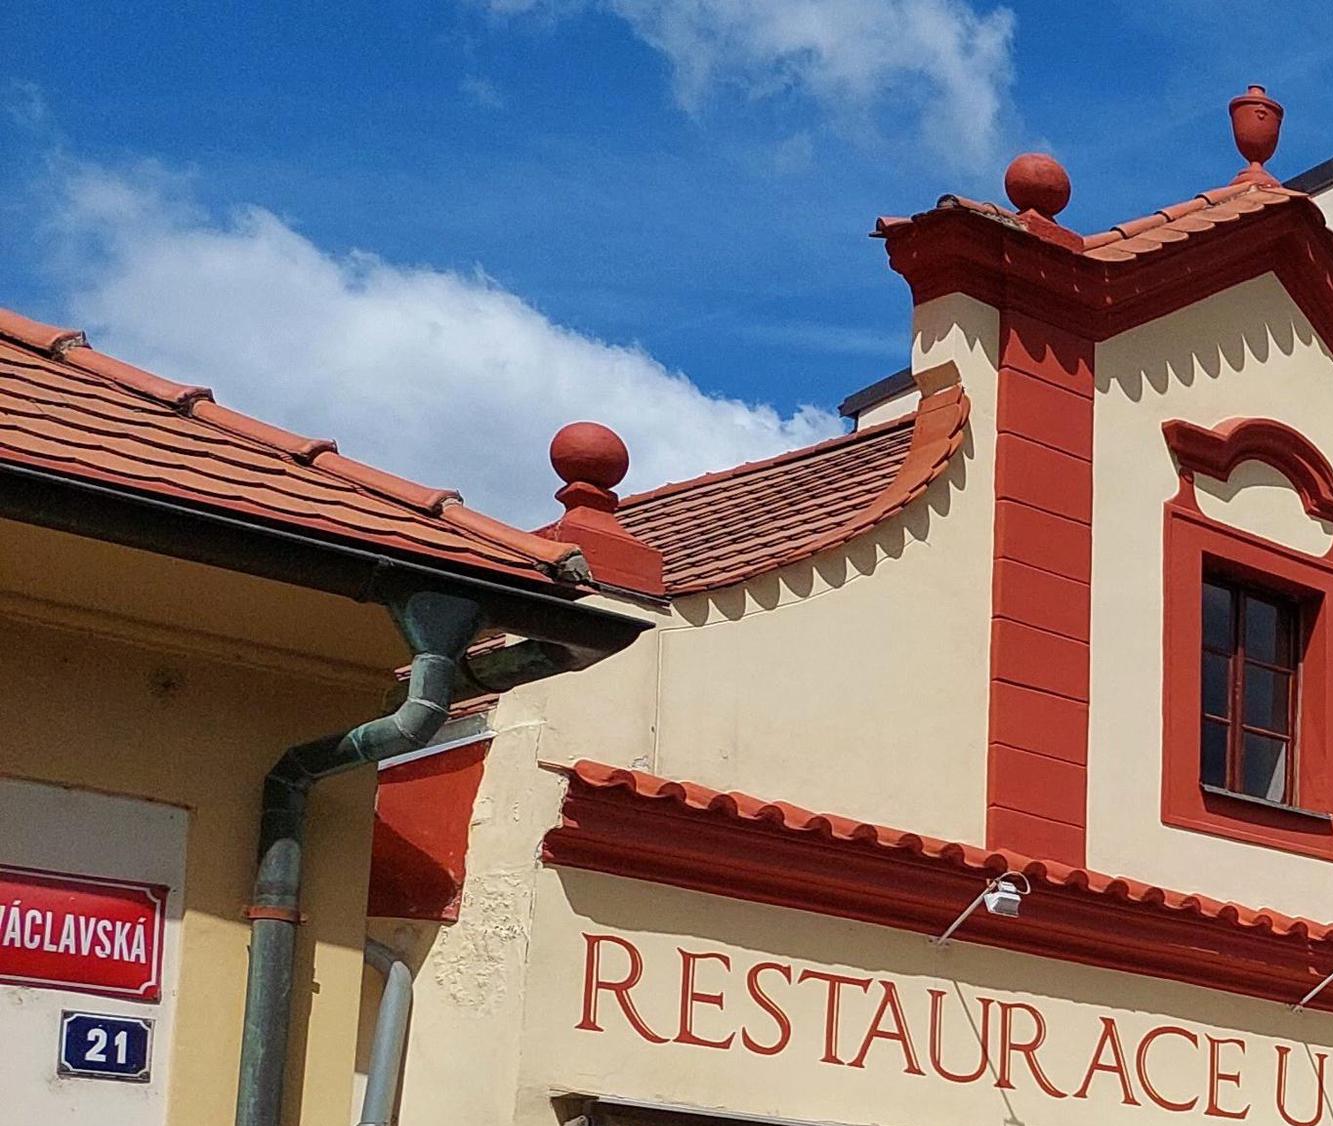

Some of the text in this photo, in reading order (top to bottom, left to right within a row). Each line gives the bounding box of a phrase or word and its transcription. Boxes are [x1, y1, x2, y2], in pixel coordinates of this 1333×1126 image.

[0, 900, 147, 964] ÁCLAVSKÁ
[85, 1028, 127, 1064] 21
[574, 932, 1251, 1120] RESTAURACE
